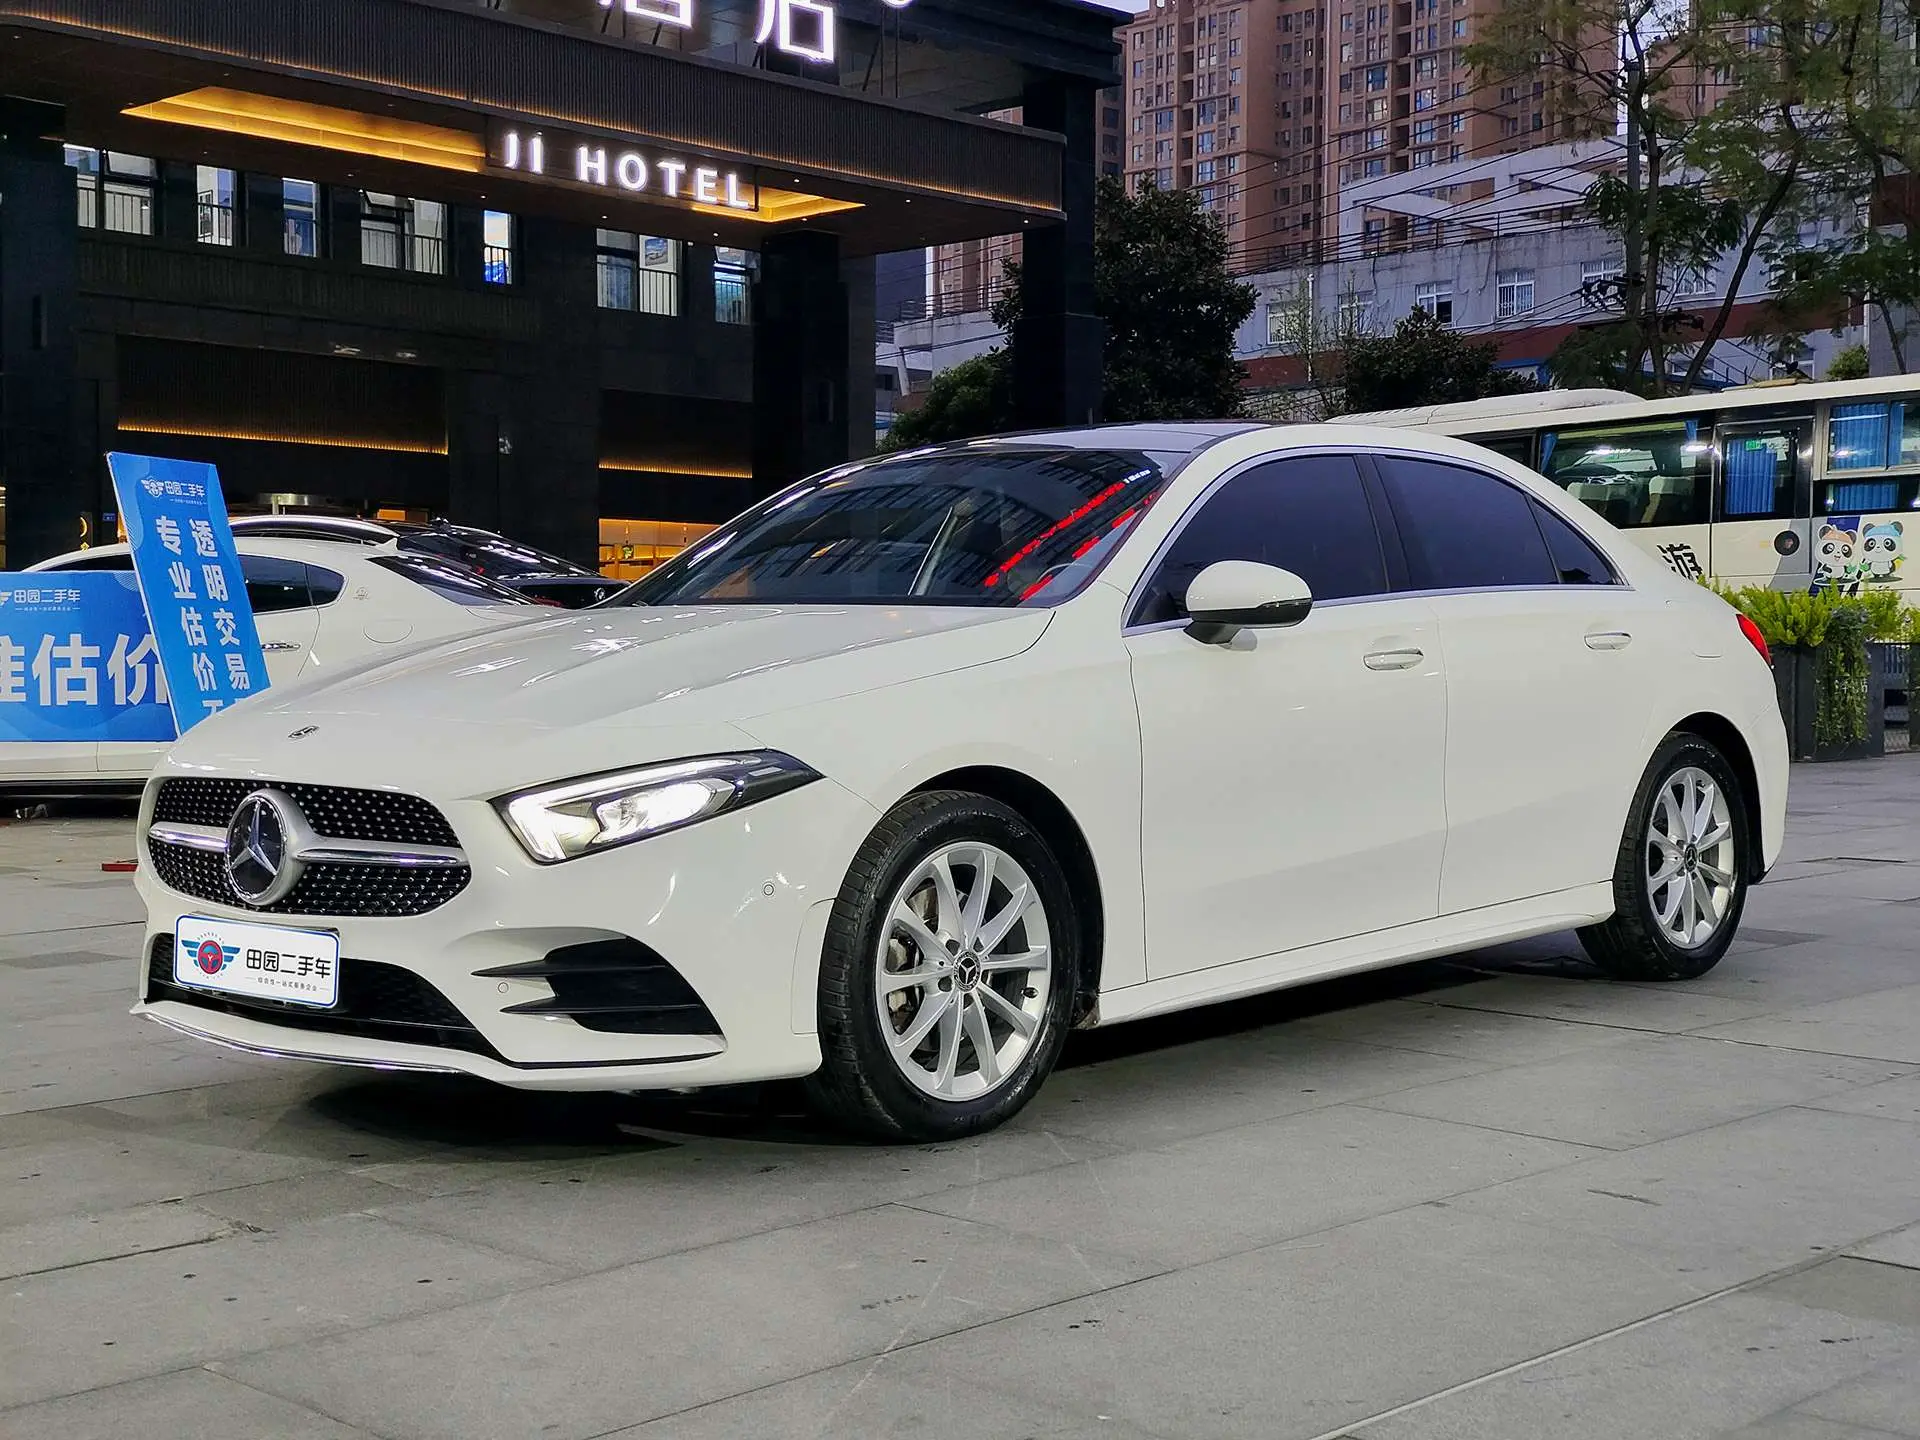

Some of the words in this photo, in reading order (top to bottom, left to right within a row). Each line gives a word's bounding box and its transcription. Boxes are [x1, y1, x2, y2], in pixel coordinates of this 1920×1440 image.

[578, 144, 750, 210] HOTEL
[14, 589, 81, 603] 田园二手车
[246, 948, 332, 979] 田园二手车
